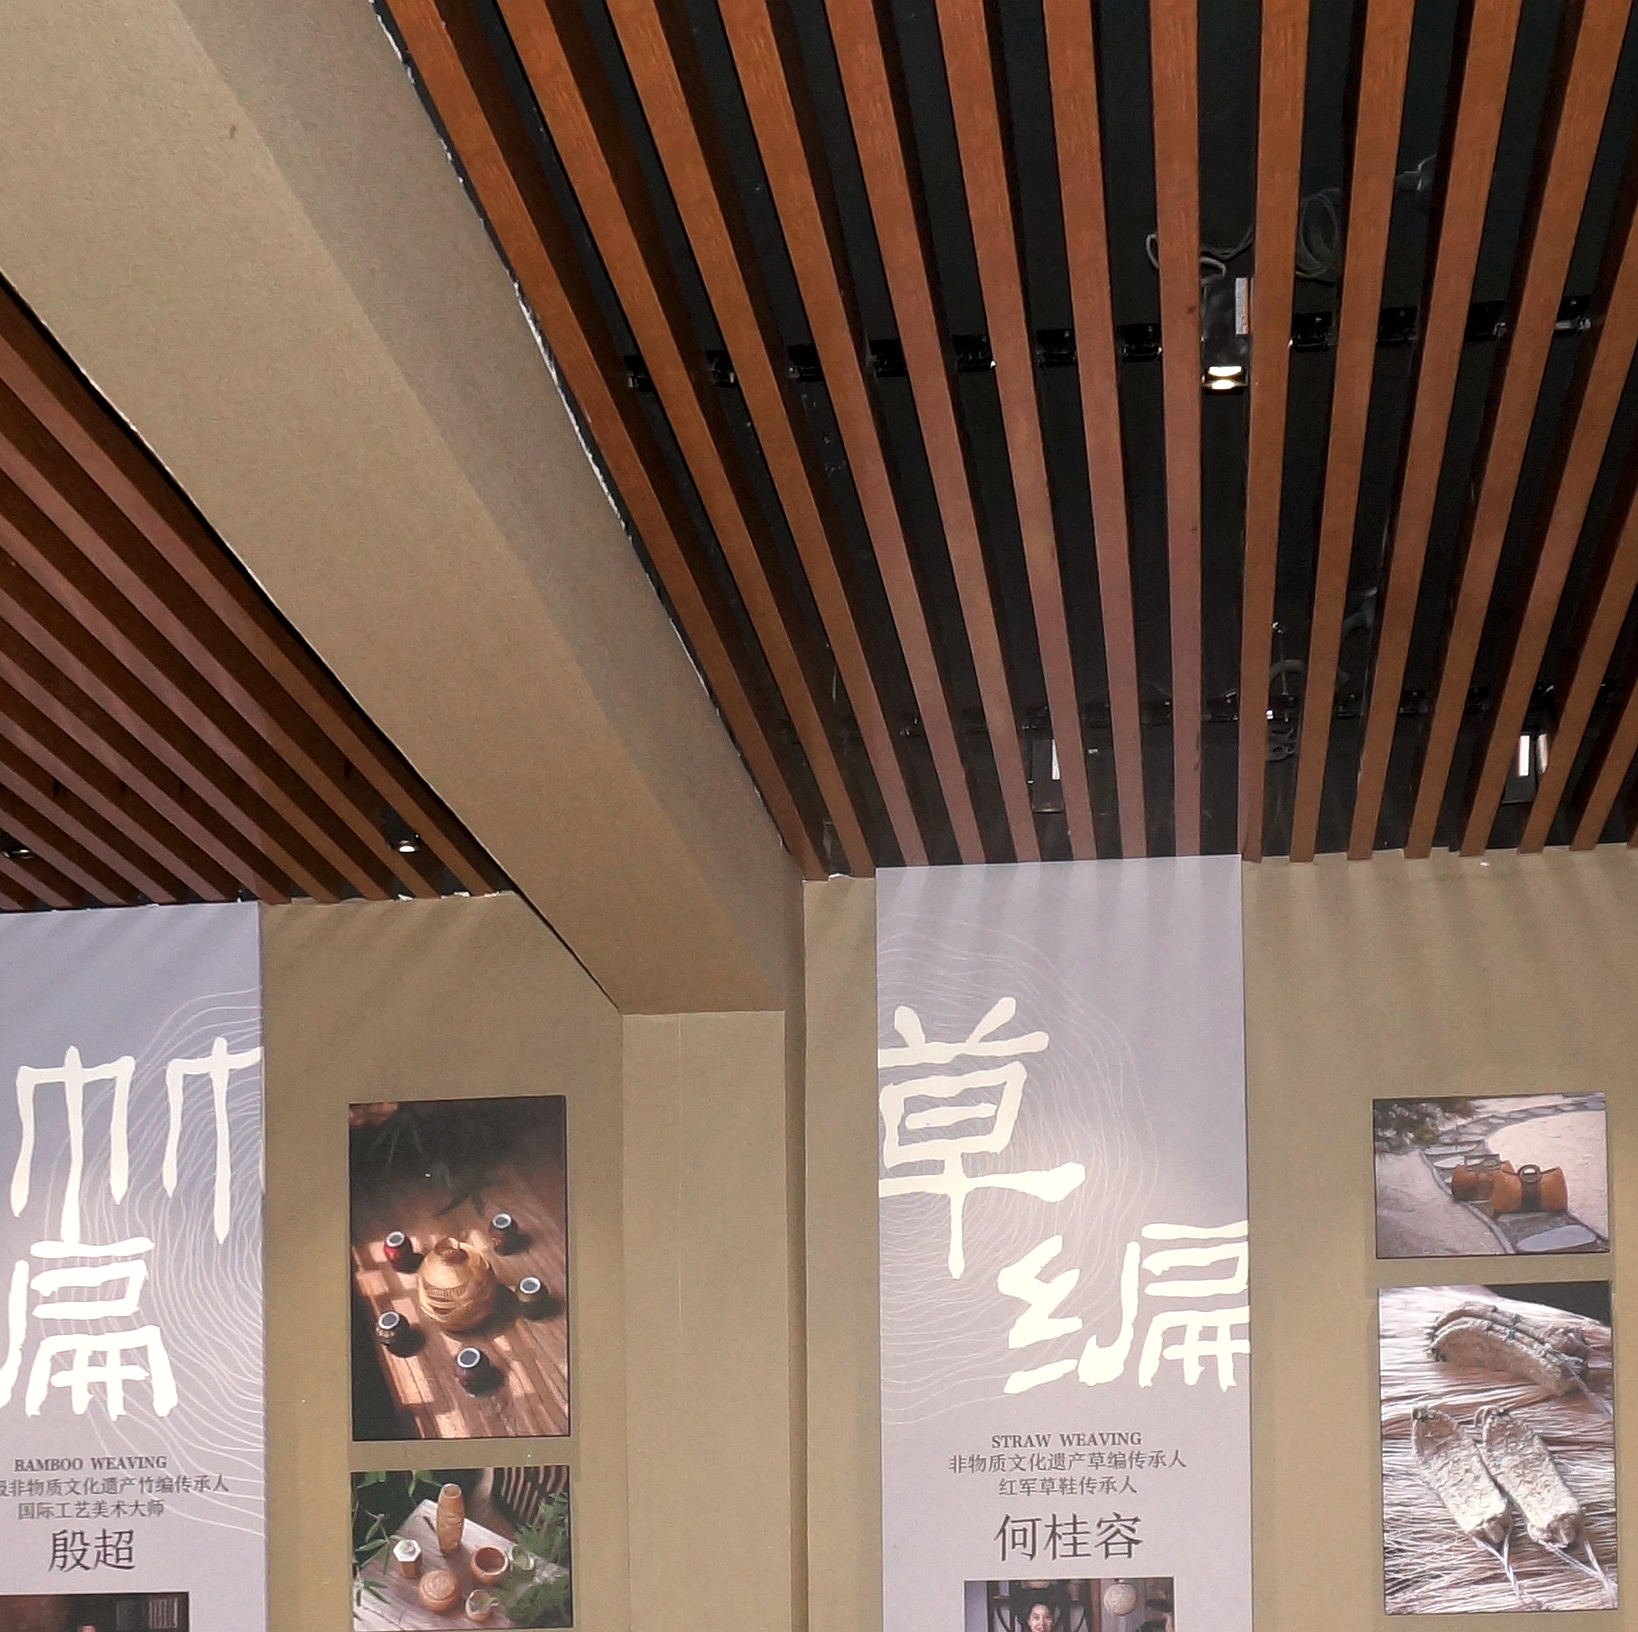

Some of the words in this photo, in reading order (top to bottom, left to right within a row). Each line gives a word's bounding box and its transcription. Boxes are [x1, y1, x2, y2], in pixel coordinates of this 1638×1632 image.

[991, 1433, 1052, 1449] STRAW
[1059, 1431, 1143, 1447] WEAVING
[13, 1458, 84, 1472] BAMBOO
[91, 1455, 167, 1471] WEAVING
[948, 1449, 1187, 1474] 非物质文化遗产草编传承人
[998, 1475, 1138, 1497] 红军草鞋传承人
[17, 1499, 165, 1520] 国际工艺美术大师
[993, 1511, 1144, 1562] 何桂容
[48, 1527, 136, 1573] 殷超
